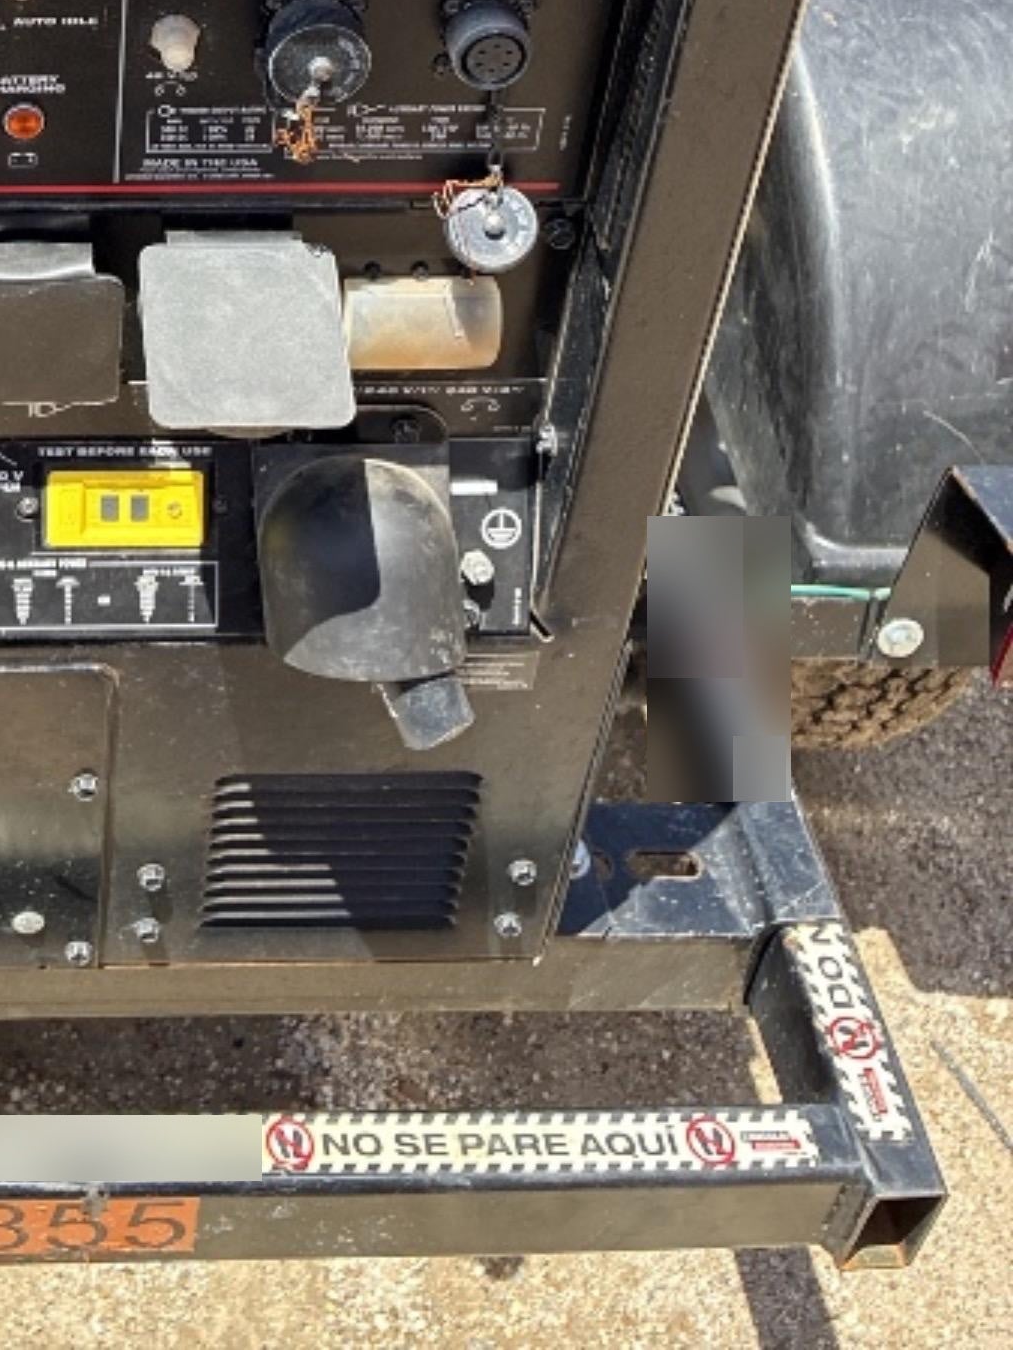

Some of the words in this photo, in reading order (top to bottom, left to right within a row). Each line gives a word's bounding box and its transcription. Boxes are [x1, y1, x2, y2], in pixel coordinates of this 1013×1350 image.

[13, 17, 58, 27] AUTO
[38, 447, 73, 457] TEST
[77, 447, 135, 457] BEFORE
[322, 1133, 383, 1157] NO
[394, 1133, 447, 1156] SE
[458, 1133, 565, 1156] PARE
